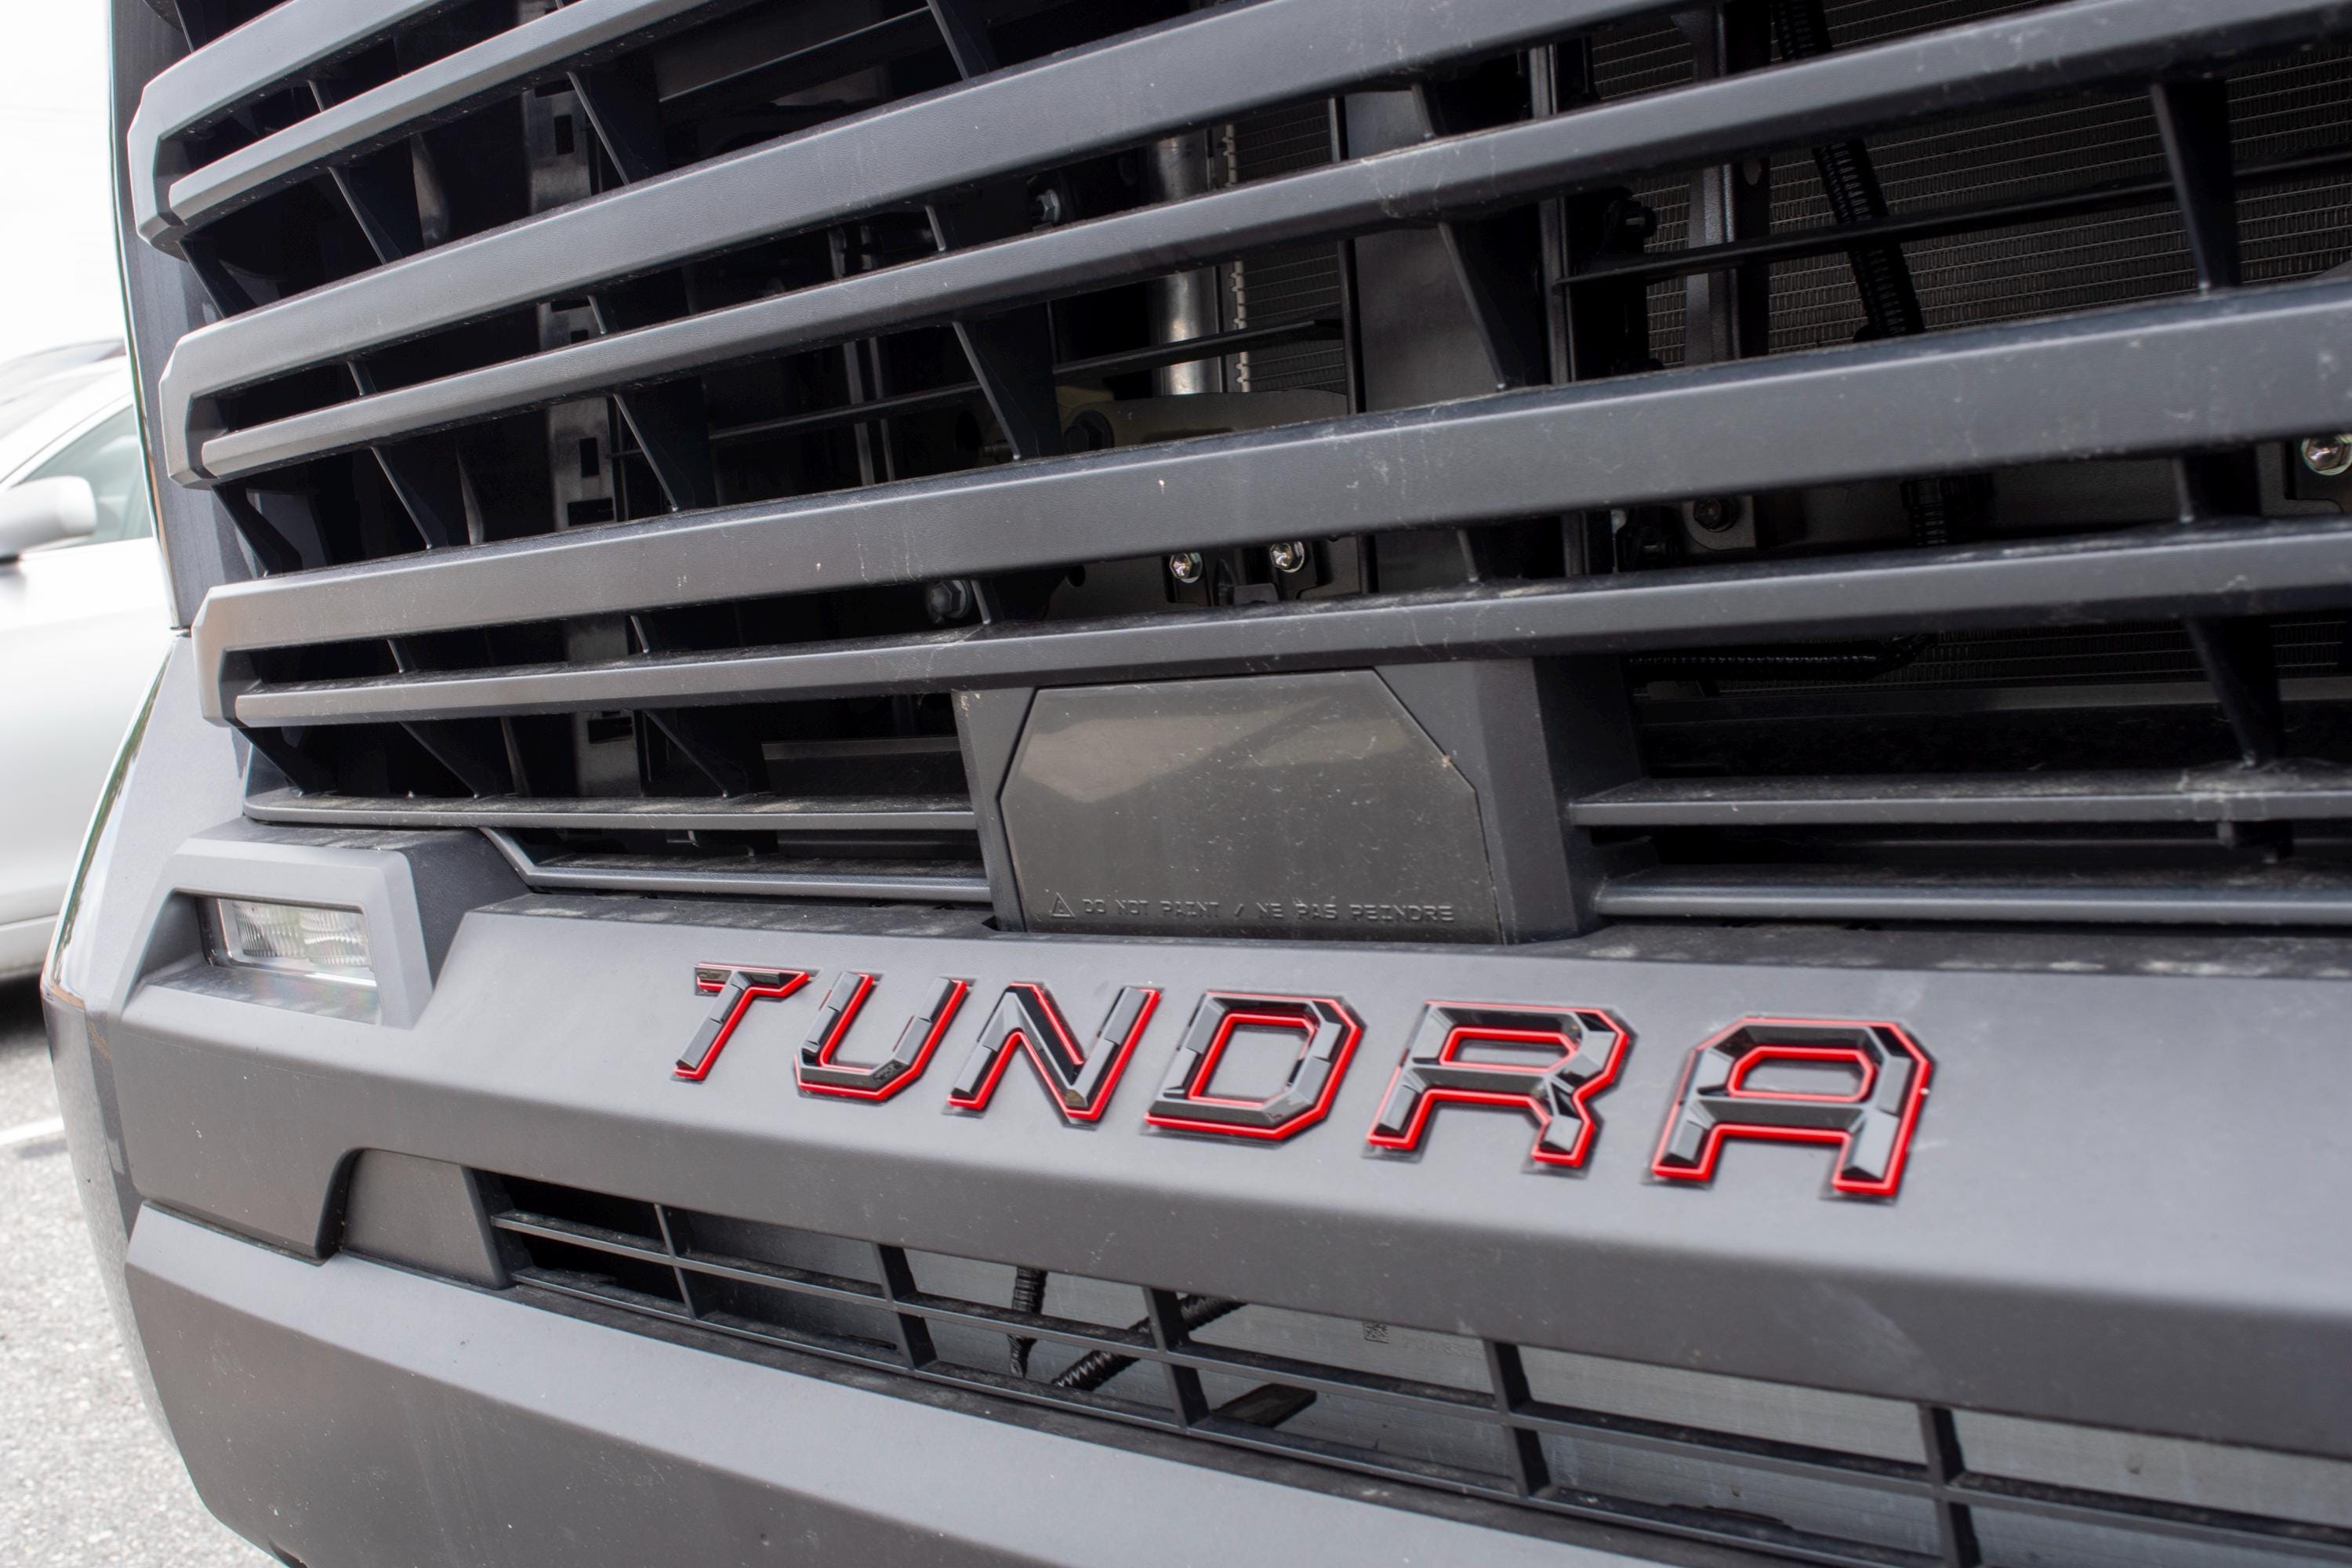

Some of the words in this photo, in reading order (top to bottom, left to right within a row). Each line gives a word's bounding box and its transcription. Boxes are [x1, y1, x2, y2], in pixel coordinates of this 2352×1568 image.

[1083, 898, 1107, 916] DO
[1115, 899, 1149, 917] NOT
[1160, 900, 1220, 918] PAINT
[1256, 902, 1284, 919] NE
[1295, 903, 1338, 920] PAS
[1348, 904, 1455, 923] PEINDRE
[672, 962, 1935, 1199] TUNDRA
